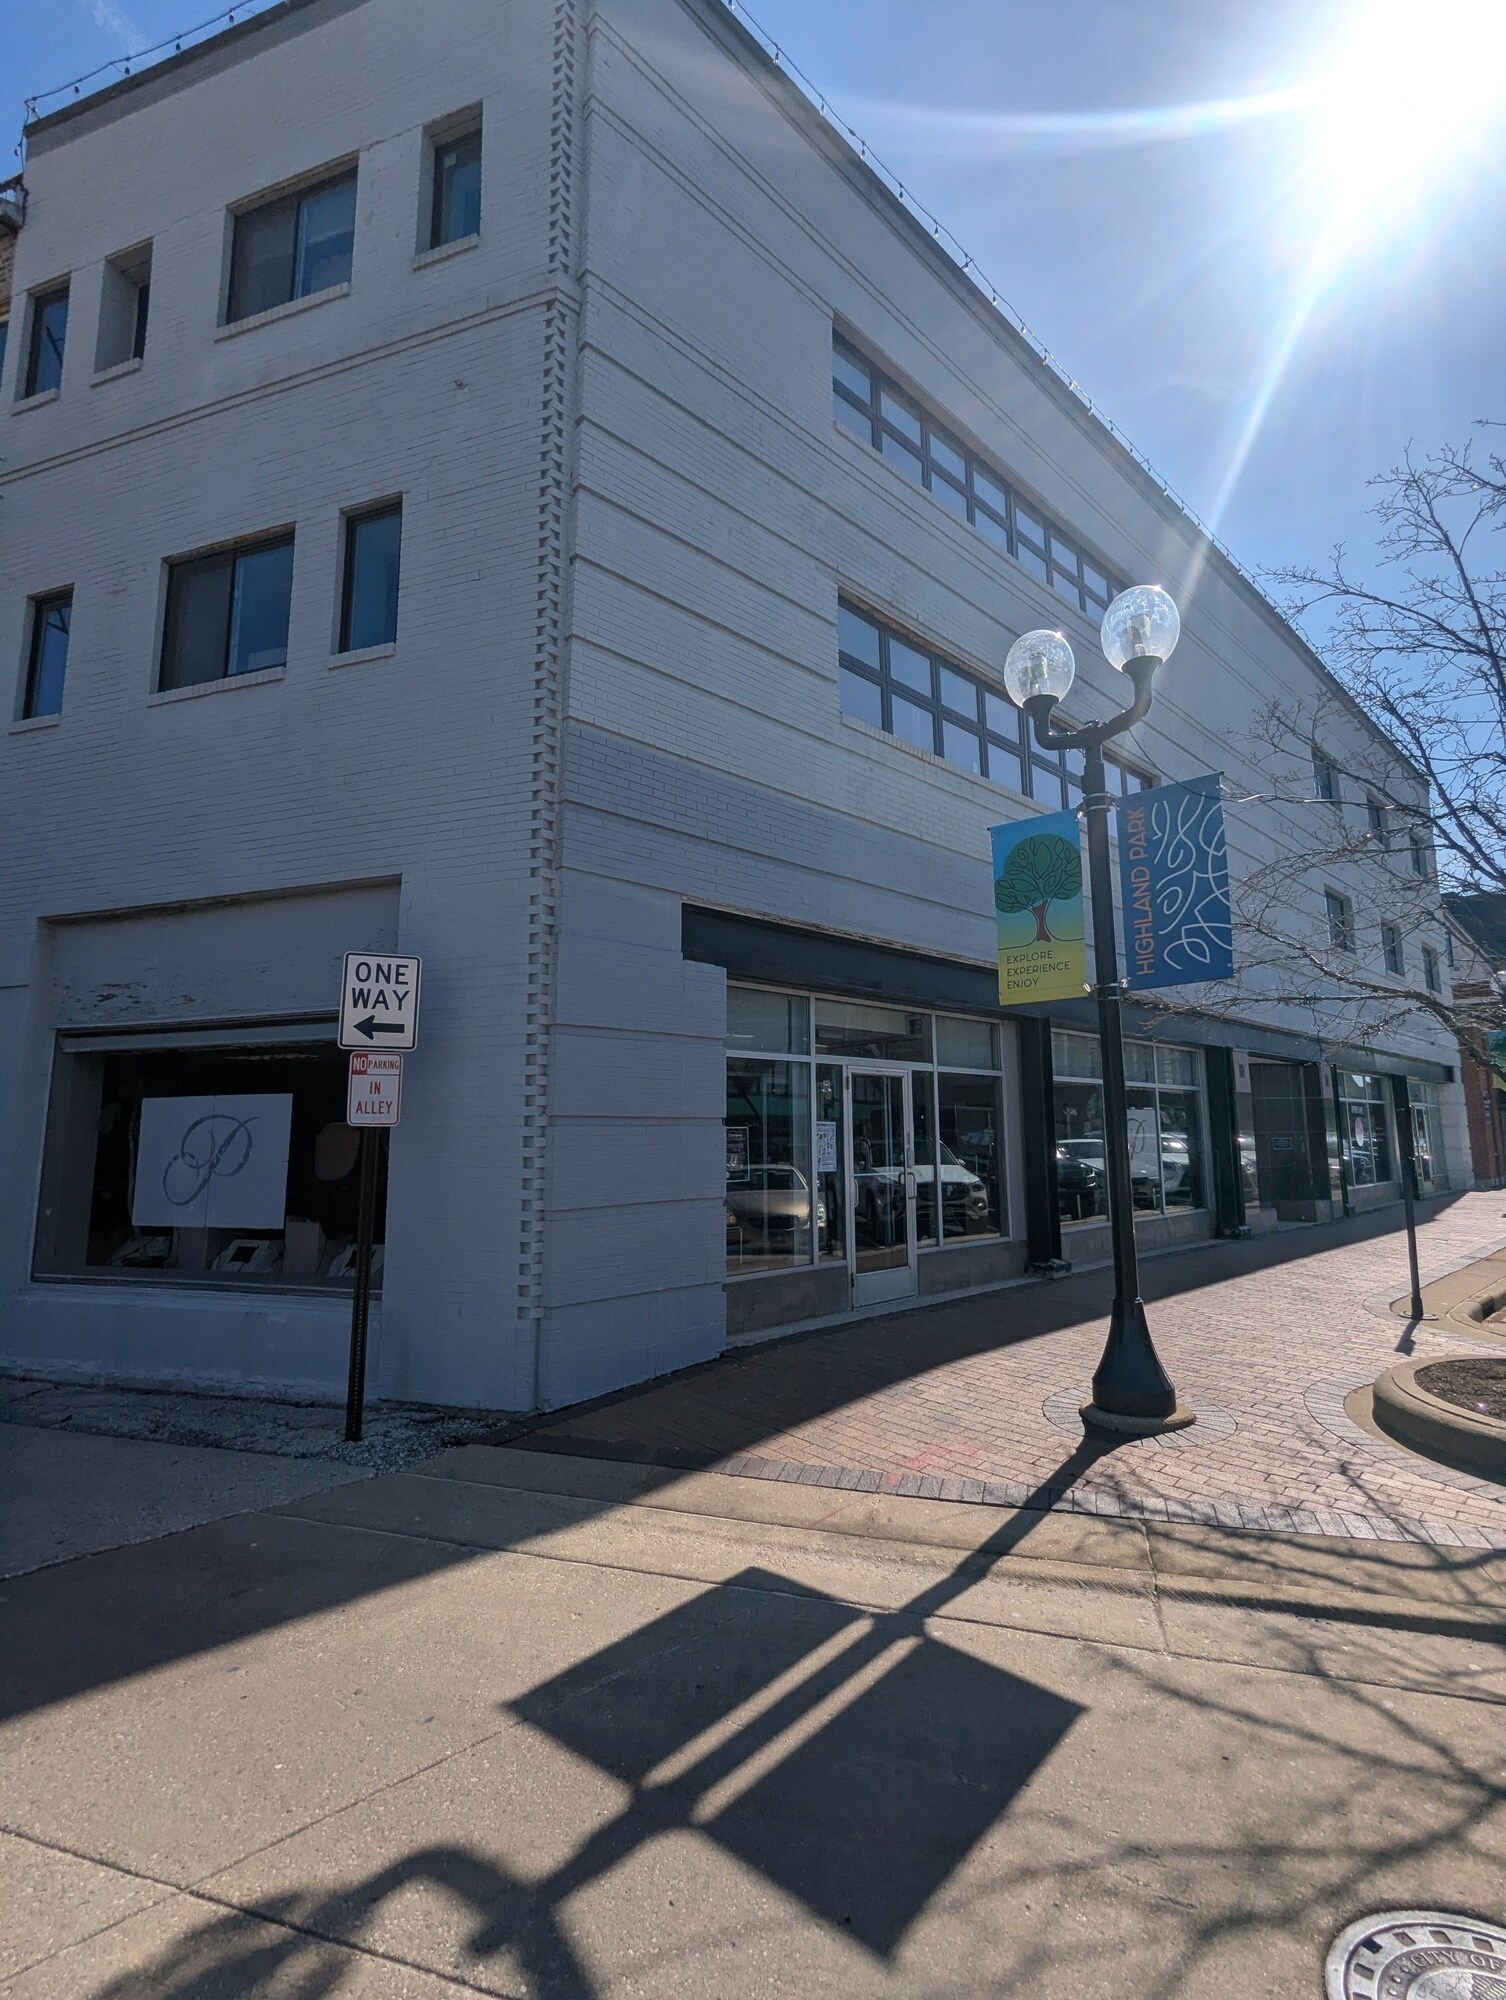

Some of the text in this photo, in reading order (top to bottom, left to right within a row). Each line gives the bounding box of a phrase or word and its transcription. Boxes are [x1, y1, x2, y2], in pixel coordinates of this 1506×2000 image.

[1126, 806, 1155, 975] HIGHLAND PARK
[1006, 950, 1053, 965] EXPLORE
[355, 961, 409, 986] ONE
[1006, 961, 1071, 977] EXPERIENCE
[1006, 977, 1039, 990] ENJOY
[351, 987, 410, 1011] WAY
[353, 1056, 399, 1071] NO PARKING
[369, 1081, 381, 1095] IN
[355, 1101, 393, 1115] ALLEY
[1410, 1950, 1501, 1971] CITY OF
